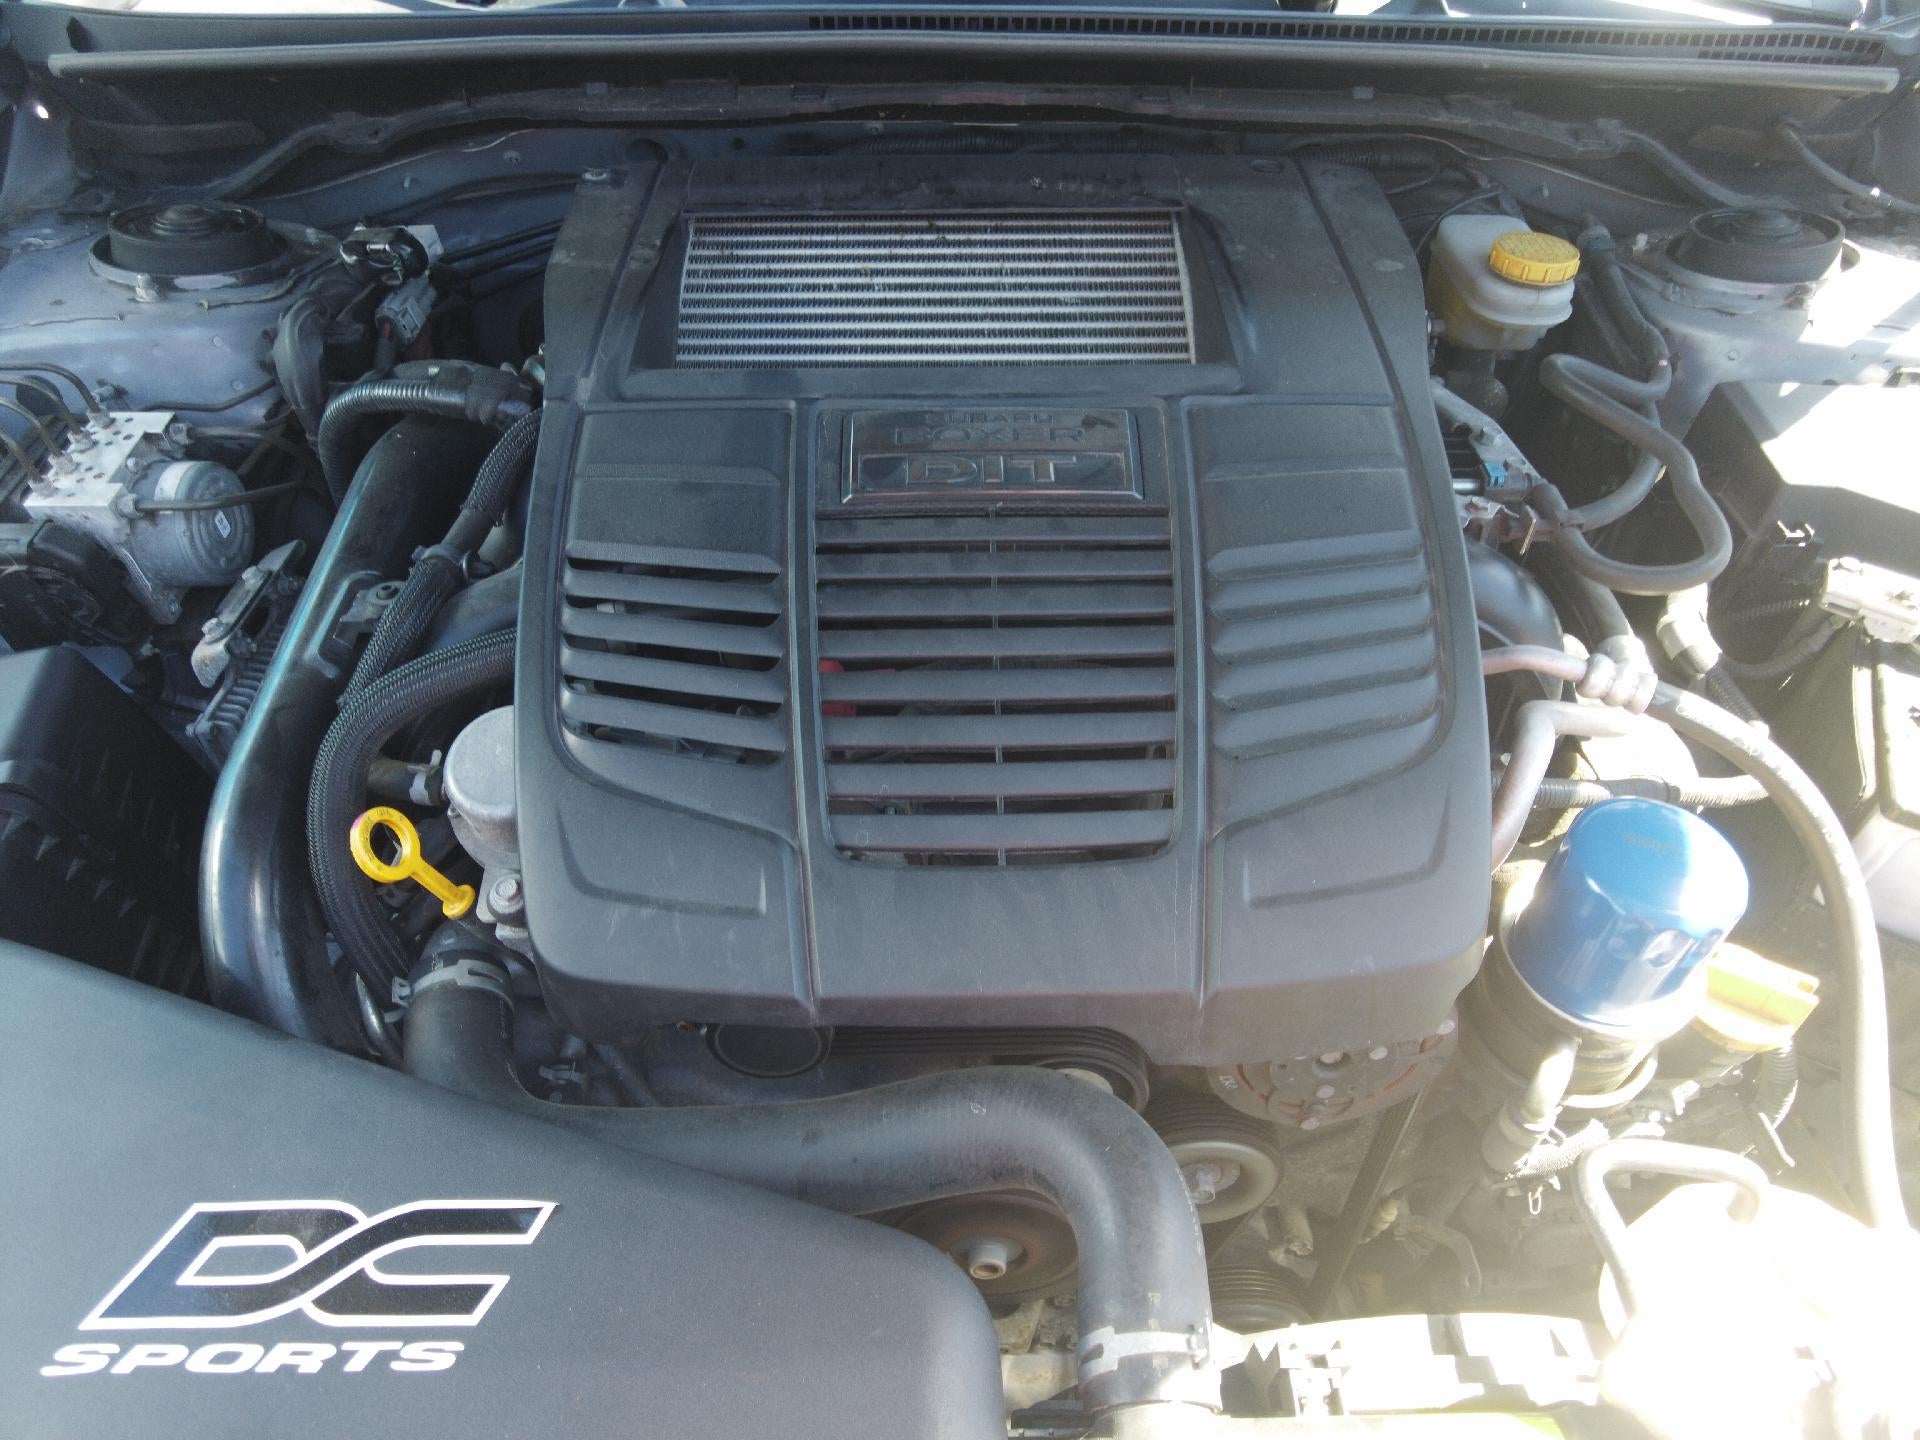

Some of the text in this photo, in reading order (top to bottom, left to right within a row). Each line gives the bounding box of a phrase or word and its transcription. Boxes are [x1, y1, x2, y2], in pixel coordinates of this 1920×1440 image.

[925, 413, 1054, 424] SUBARU
[894, 427, 1087, 445] BOXER
[904, 454, 1078, 484] DIT
[78, 1199, 560, 1330] DC
[40, 1341, 465, 1376] SPORTS
